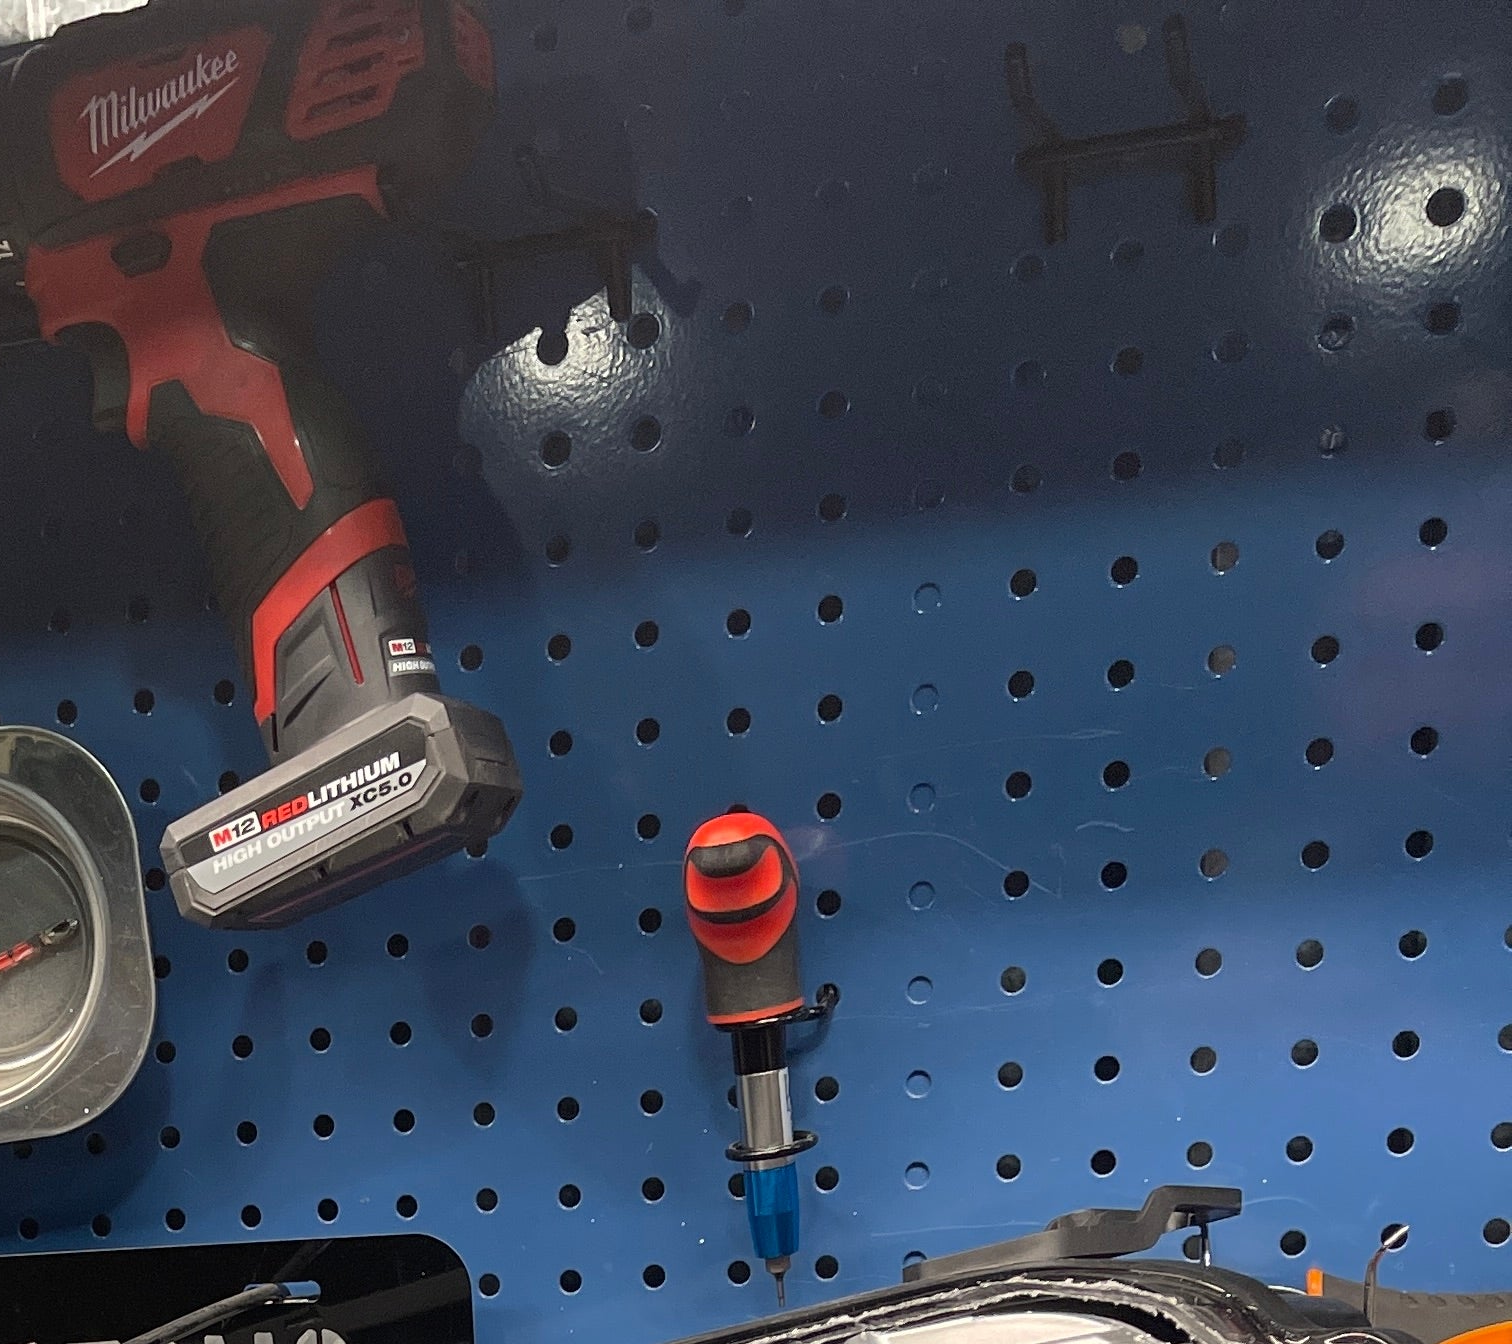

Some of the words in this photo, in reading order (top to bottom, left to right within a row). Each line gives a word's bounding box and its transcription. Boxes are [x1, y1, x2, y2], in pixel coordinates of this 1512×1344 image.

[79, 50, 239, 155] Milwaukee
[391, 642, 414, 652] M12
[211, 816, 257, 848] M12
[212, 839, 262, 875] HIGH
[266, 800, 346, 850] OUTPUT
[350, 771, 413, 812] XC5.0
